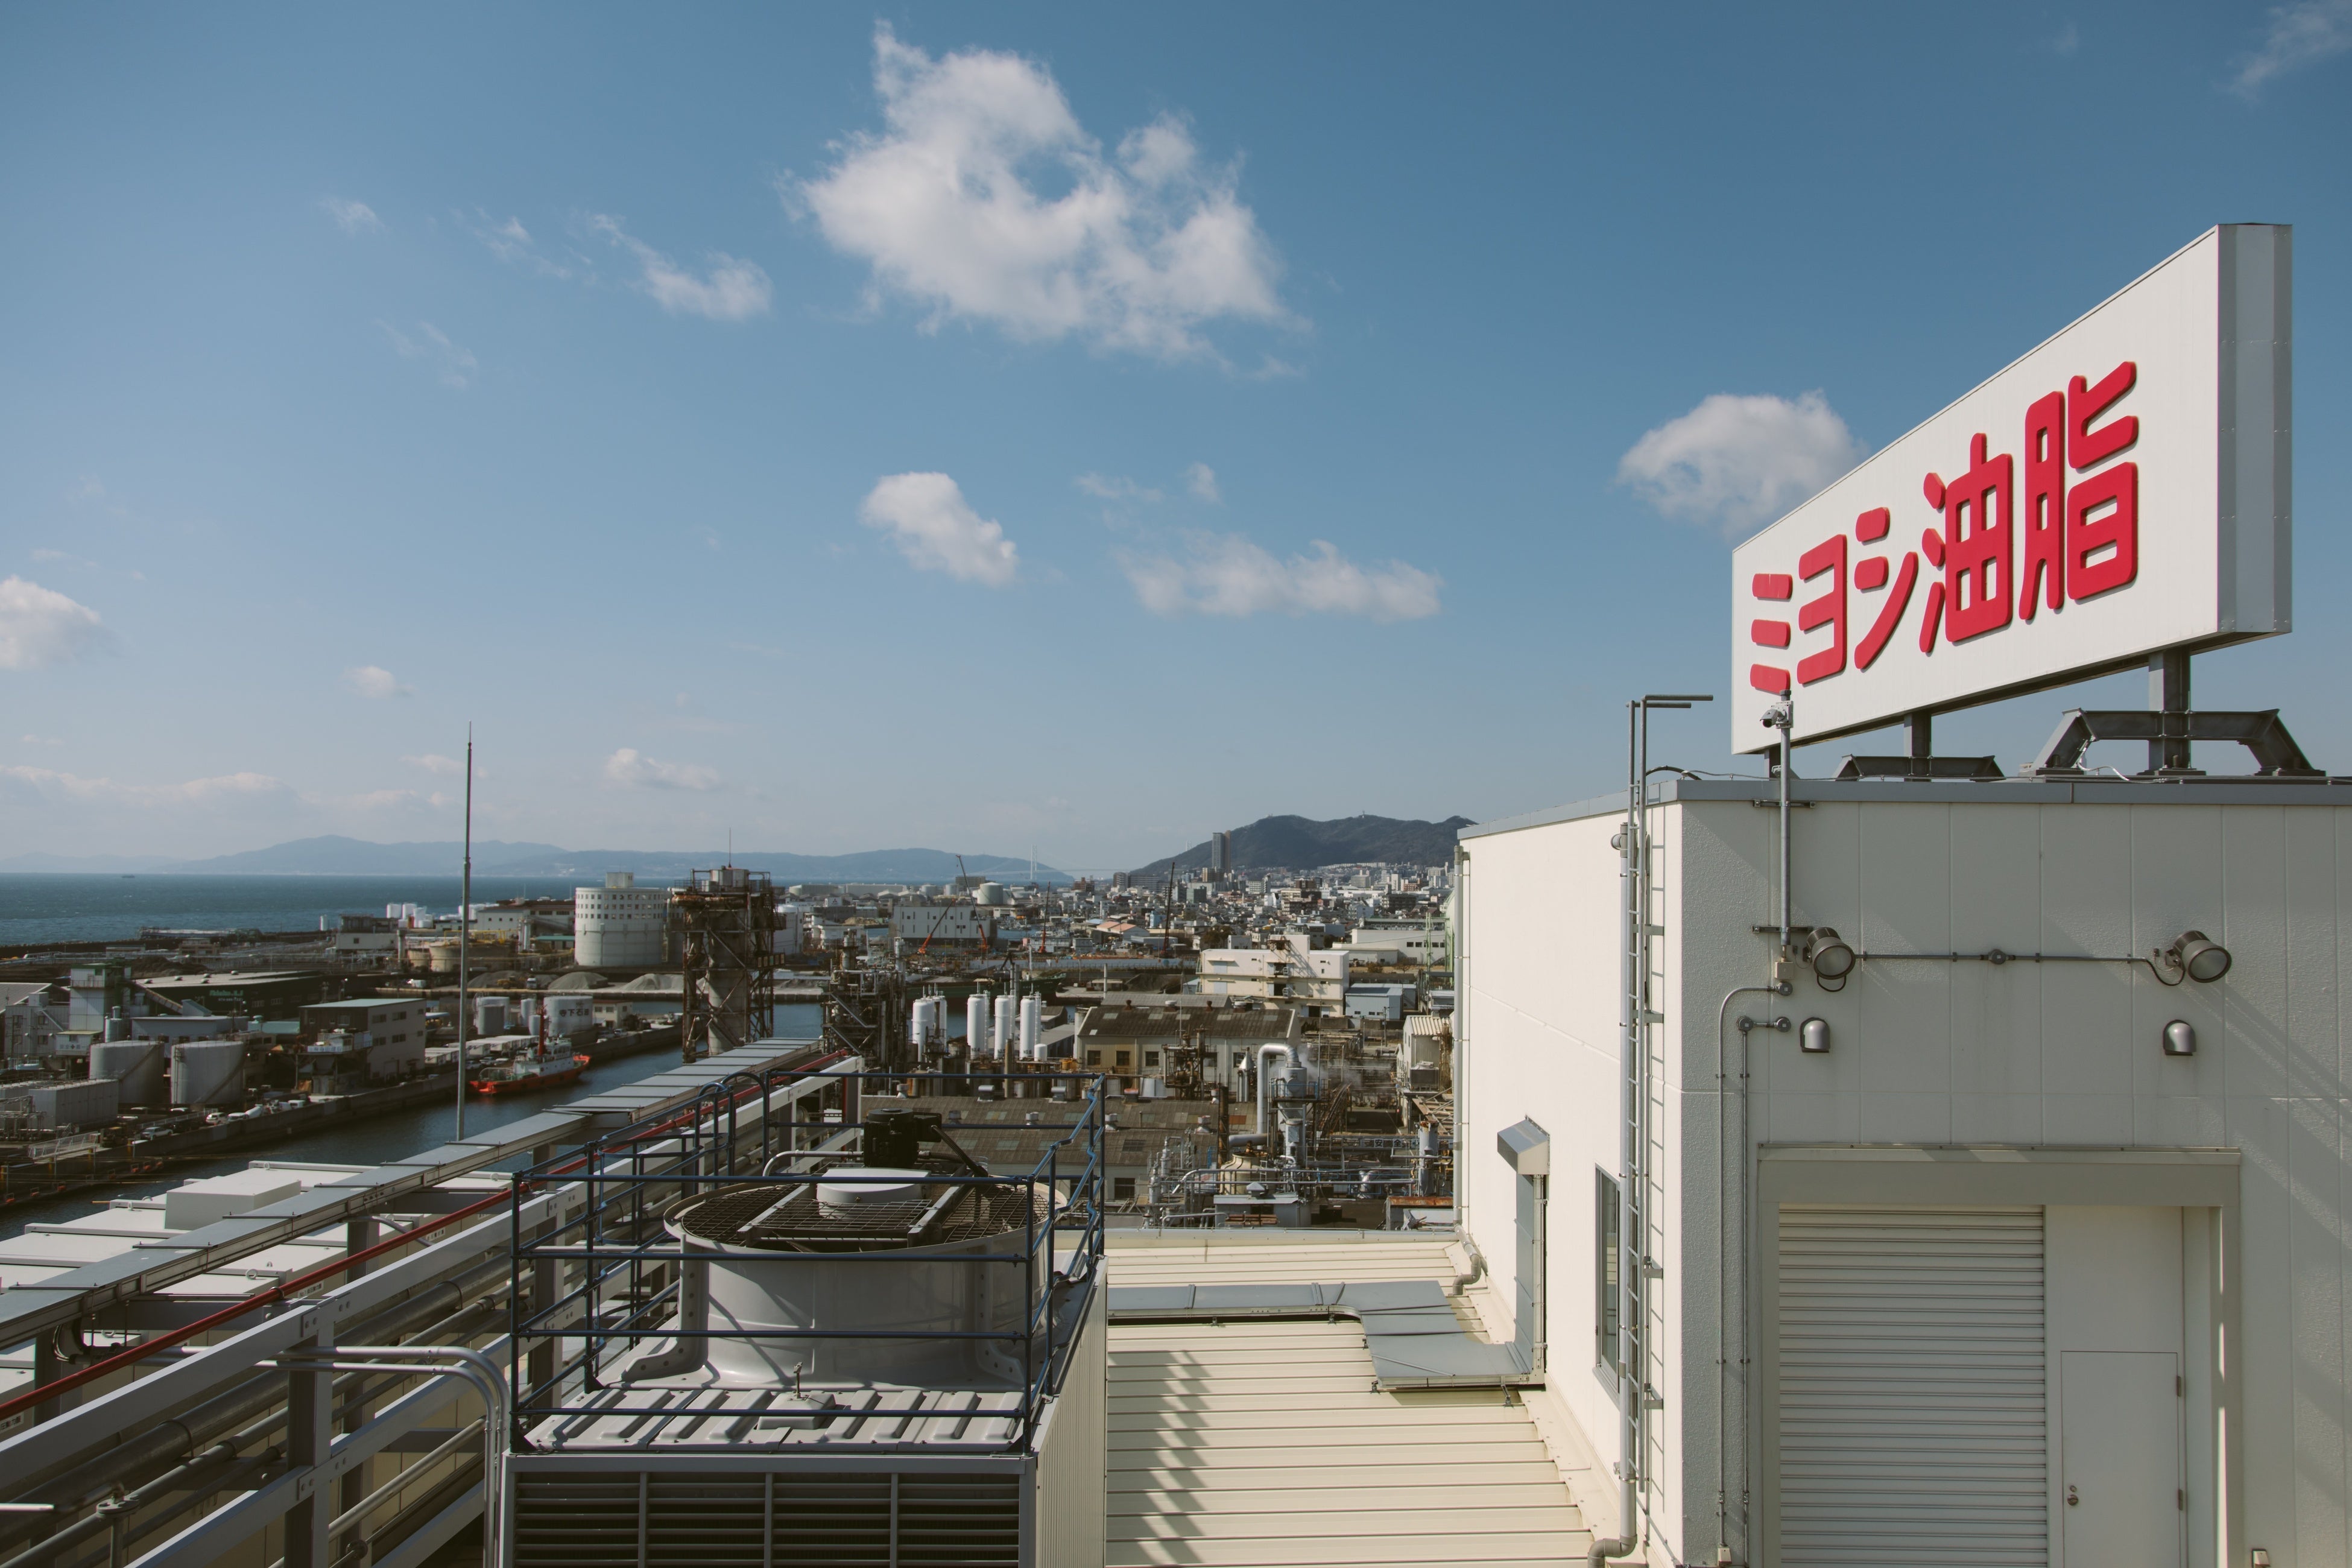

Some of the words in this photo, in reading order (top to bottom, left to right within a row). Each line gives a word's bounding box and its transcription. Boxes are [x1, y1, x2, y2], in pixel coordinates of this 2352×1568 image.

[1750, 361, 2138, 694] ミヨシ油脂
